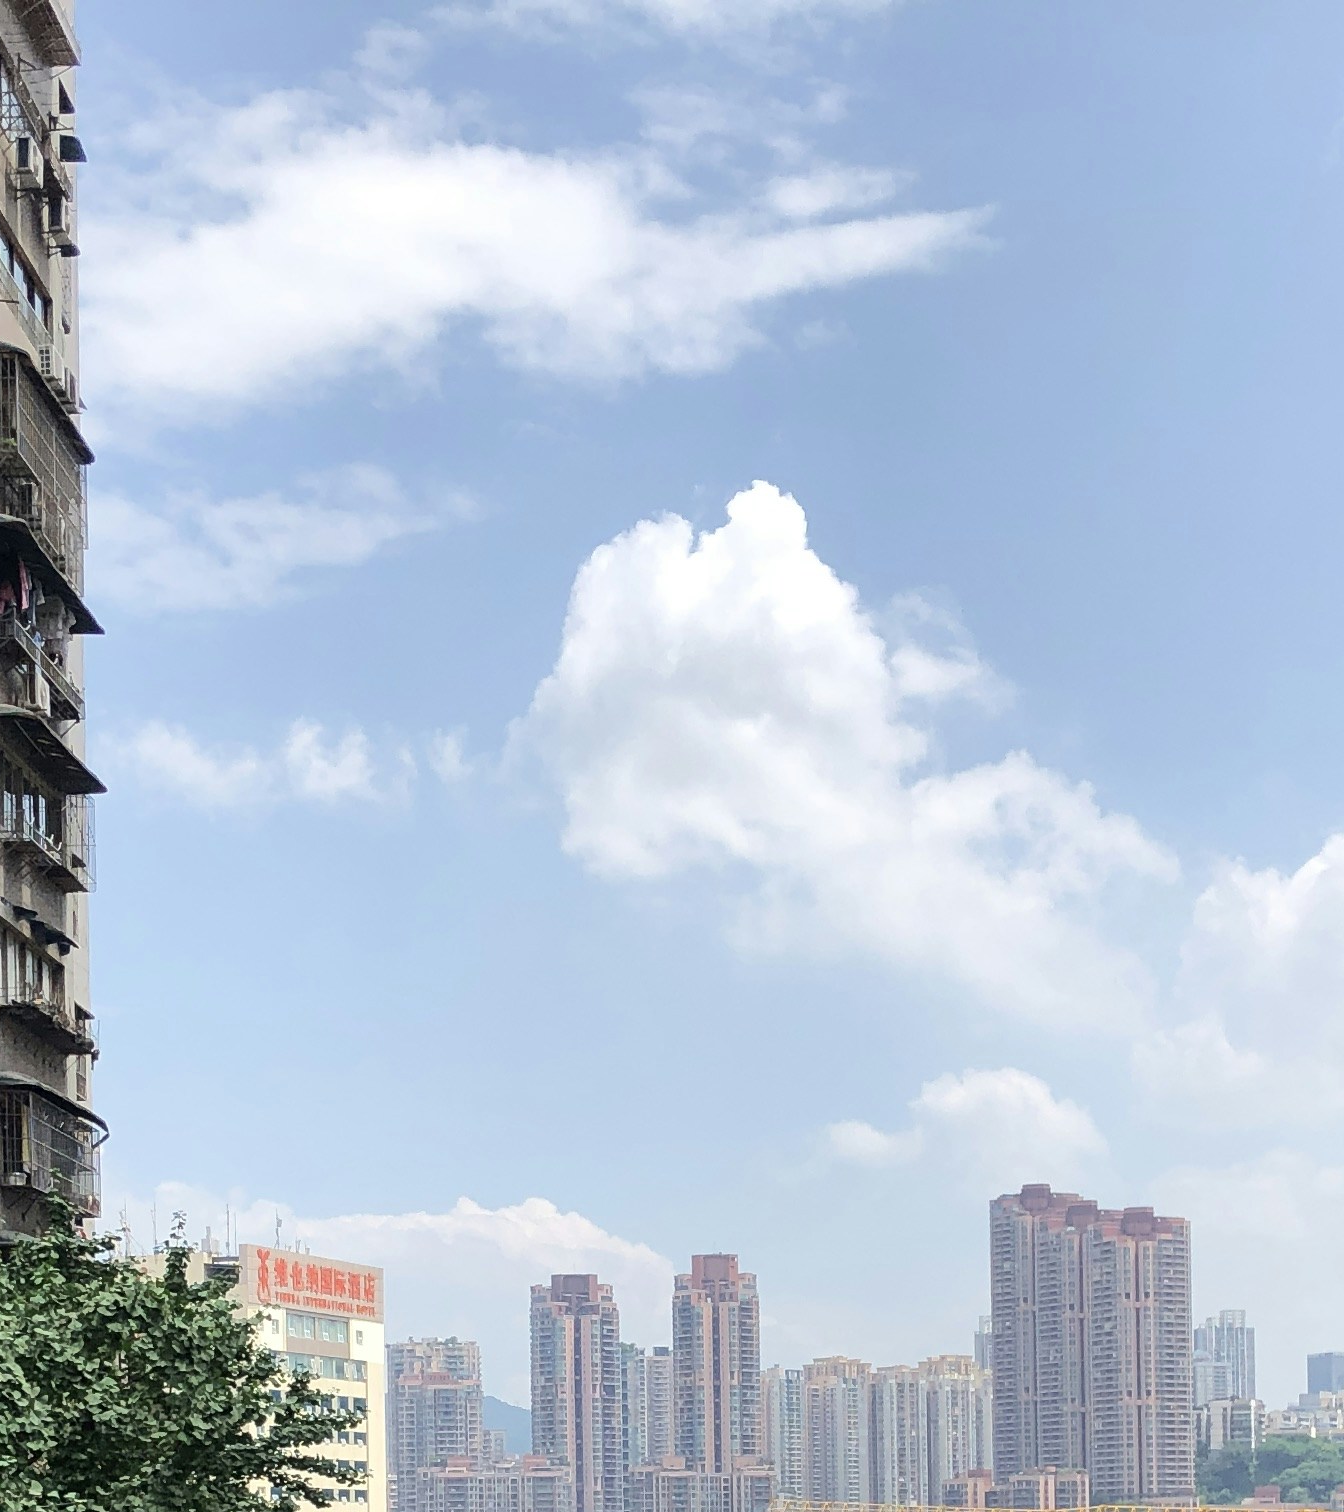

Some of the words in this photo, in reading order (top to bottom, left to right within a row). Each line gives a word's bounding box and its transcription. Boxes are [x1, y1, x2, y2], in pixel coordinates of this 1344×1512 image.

[274, 1257, 375, 1304] 维也纳国际酒店
